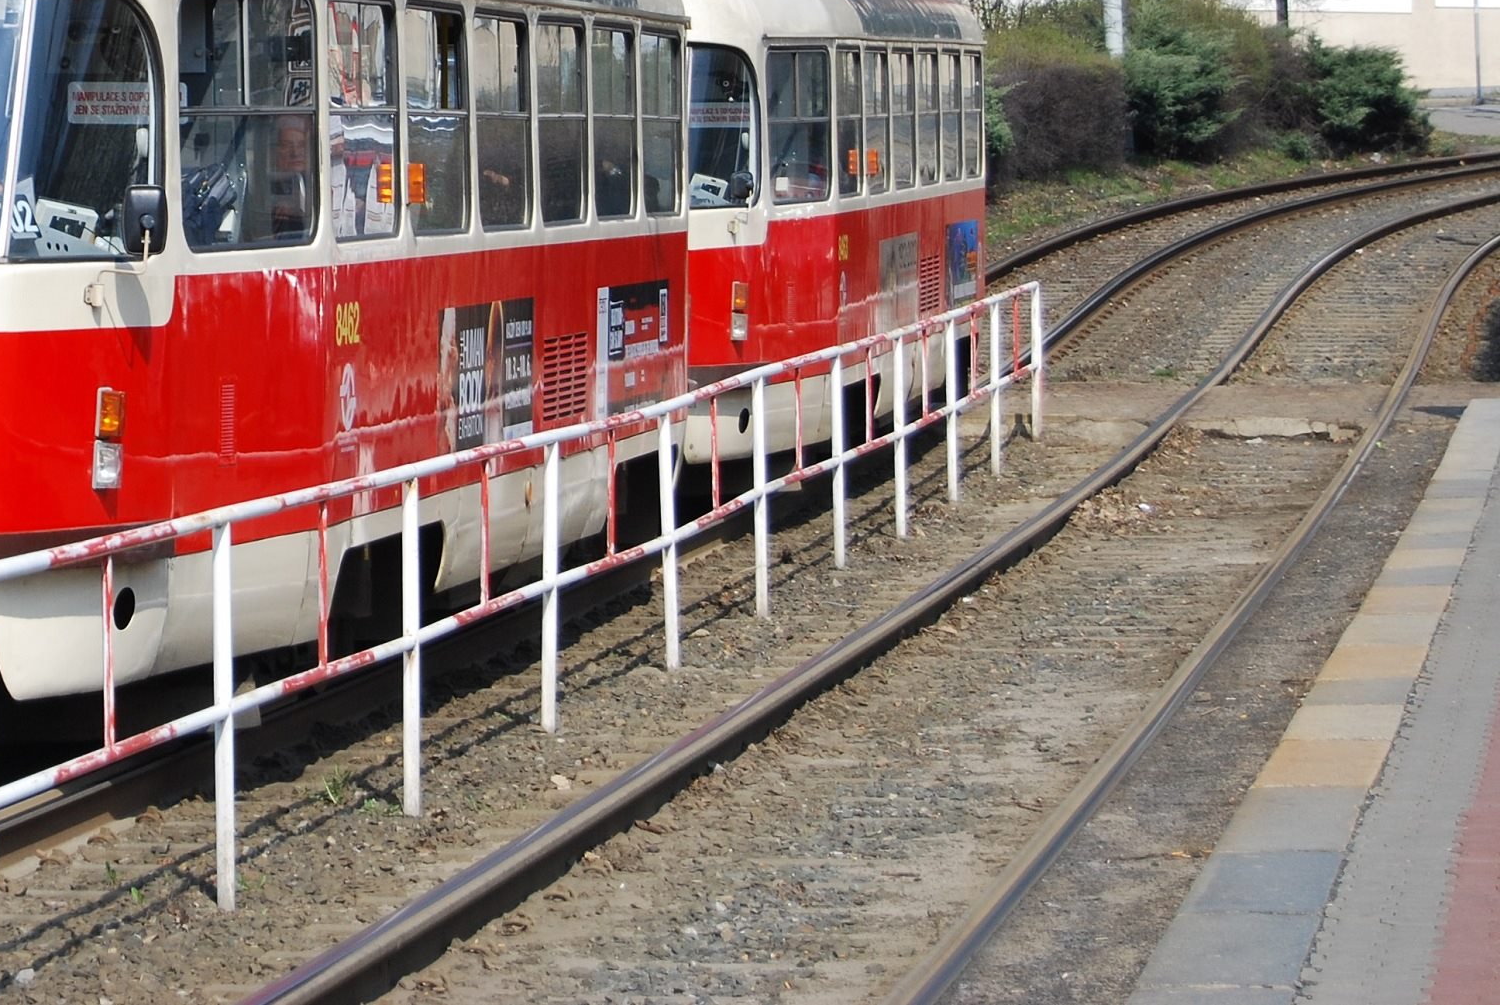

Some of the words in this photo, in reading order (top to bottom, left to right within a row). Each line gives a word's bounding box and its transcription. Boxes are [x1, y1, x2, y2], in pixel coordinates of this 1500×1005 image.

[336, 301, 360, 347] 8462
[463, 327, 485, 369] HUMAN
[459, 369, 484, 415] BODY
